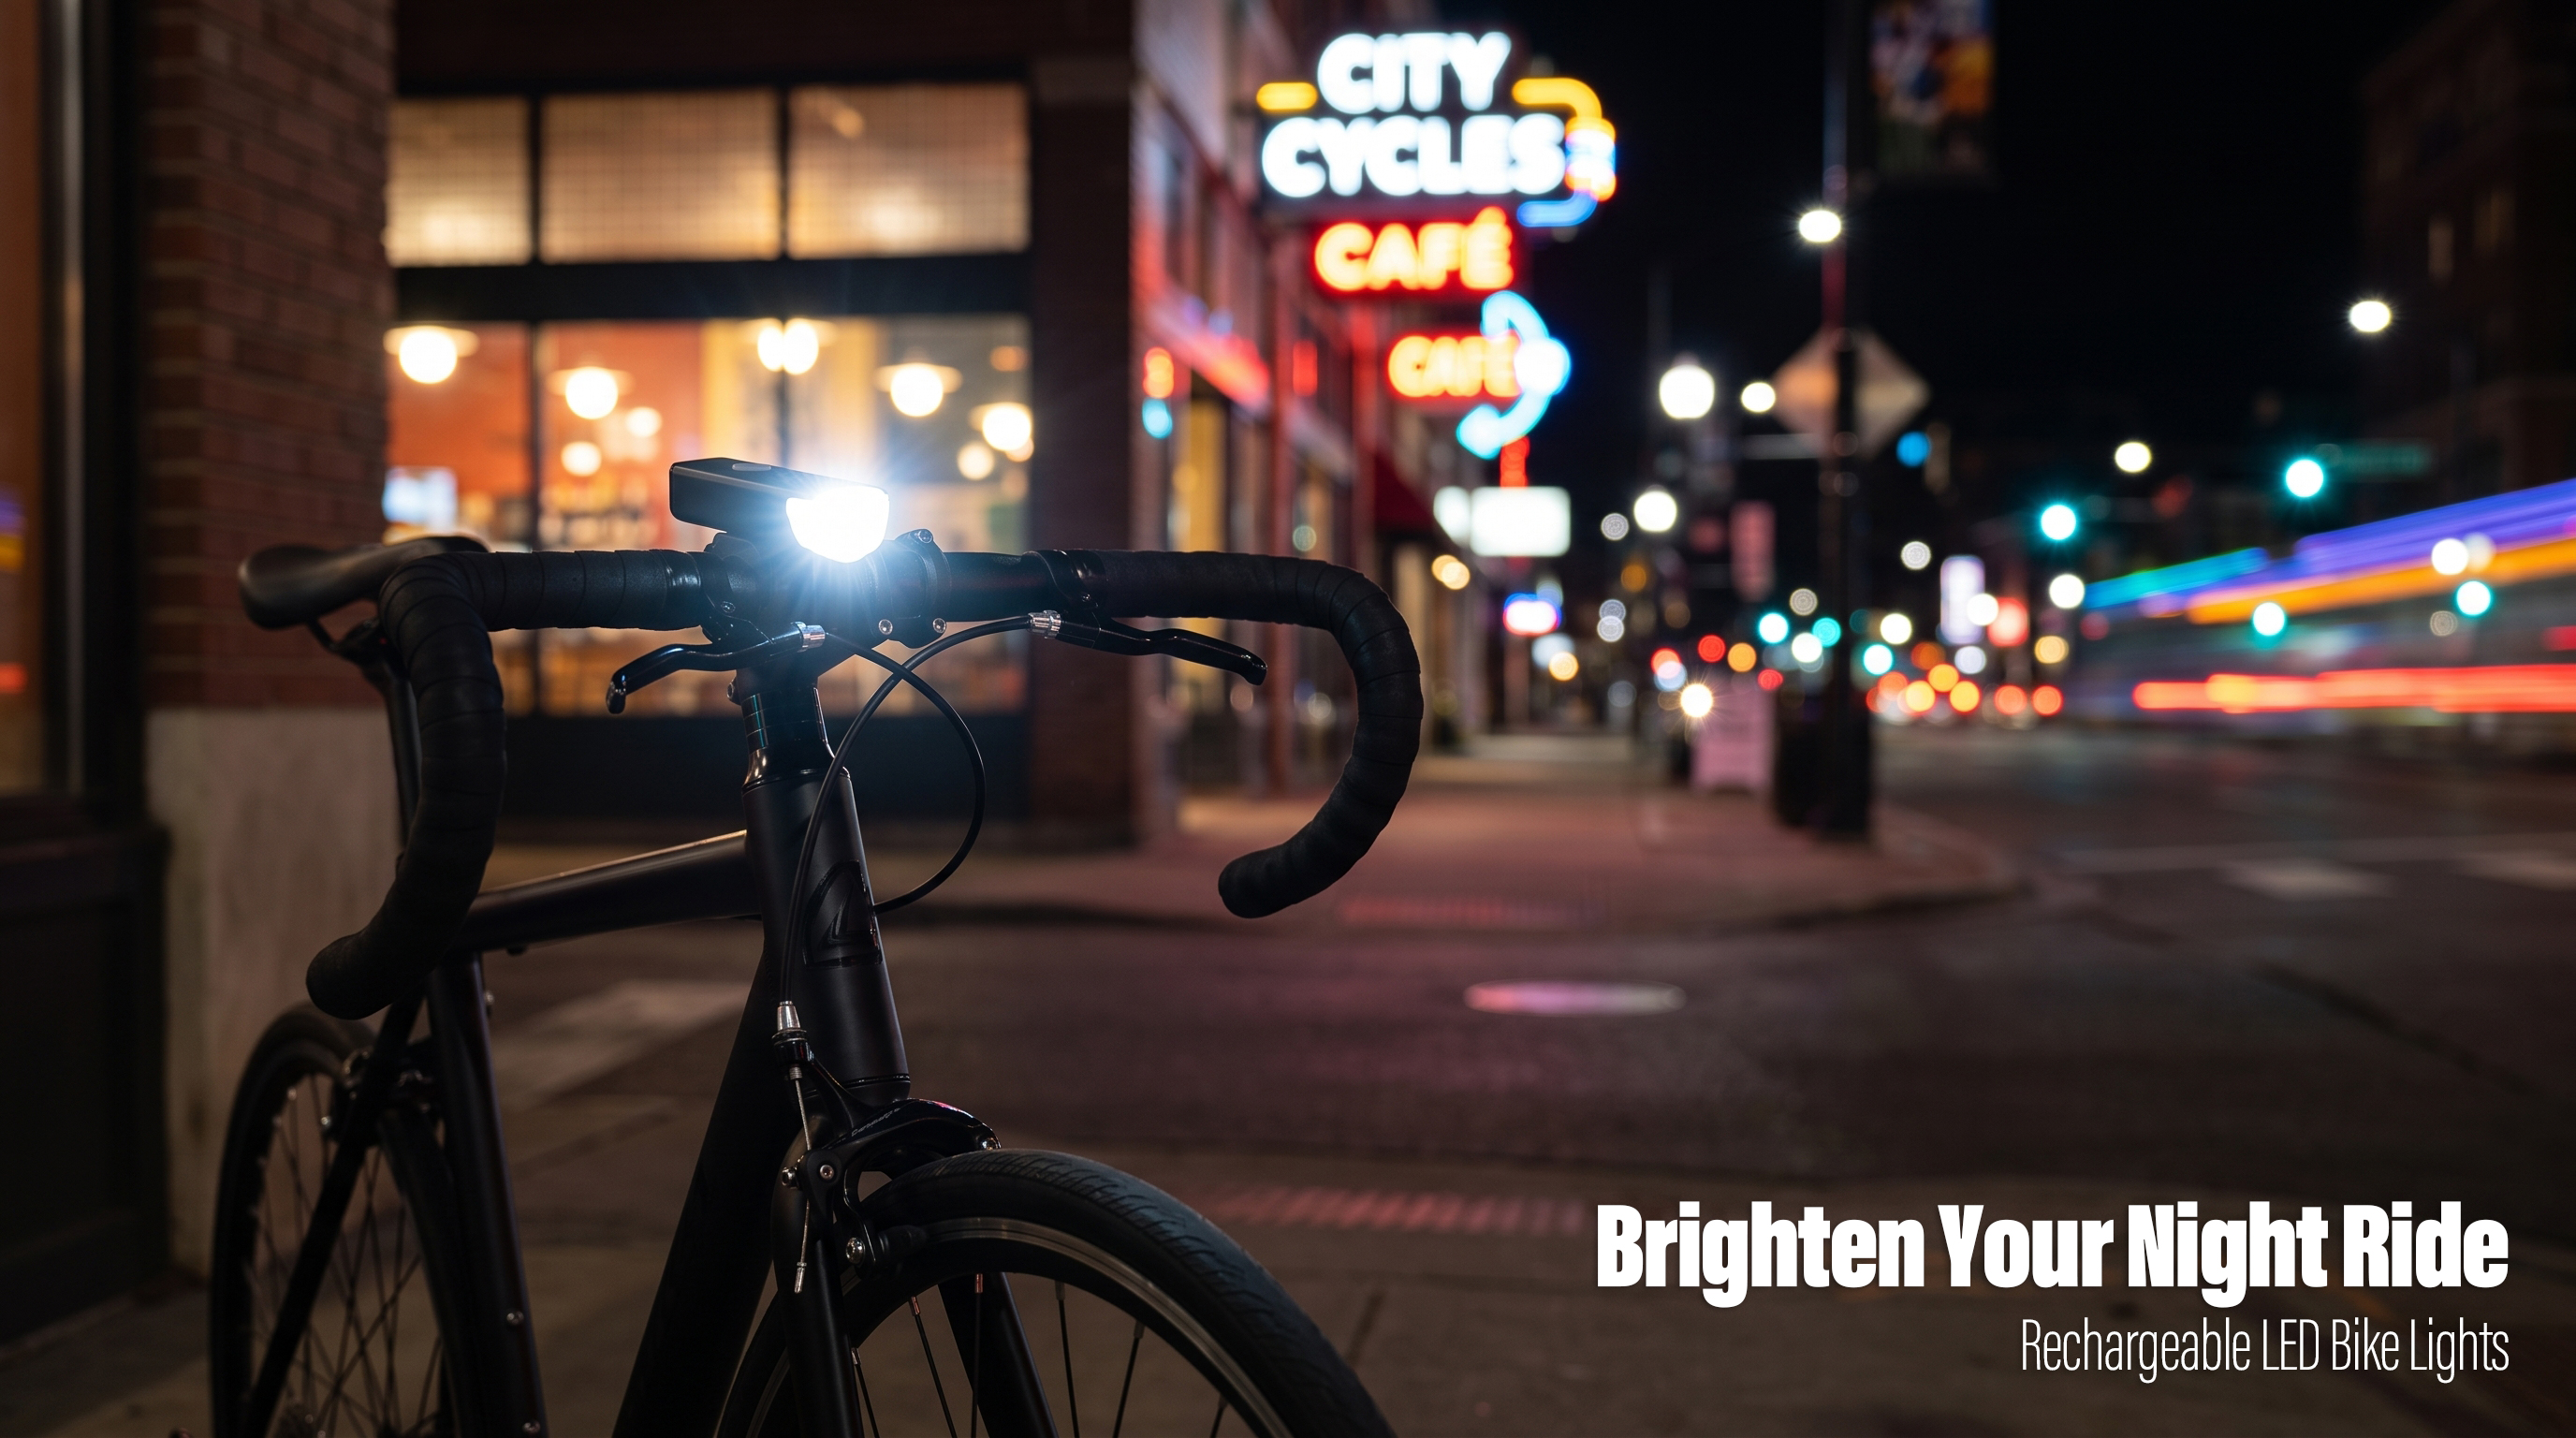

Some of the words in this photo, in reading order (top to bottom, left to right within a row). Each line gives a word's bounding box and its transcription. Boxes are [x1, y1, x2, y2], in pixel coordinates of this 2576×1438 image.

[1317, 32, 1512, 114] CITY
[1261, 113, 1567, 198] CYCLES
[1314, 206, 1513, 291] CAFÉ
